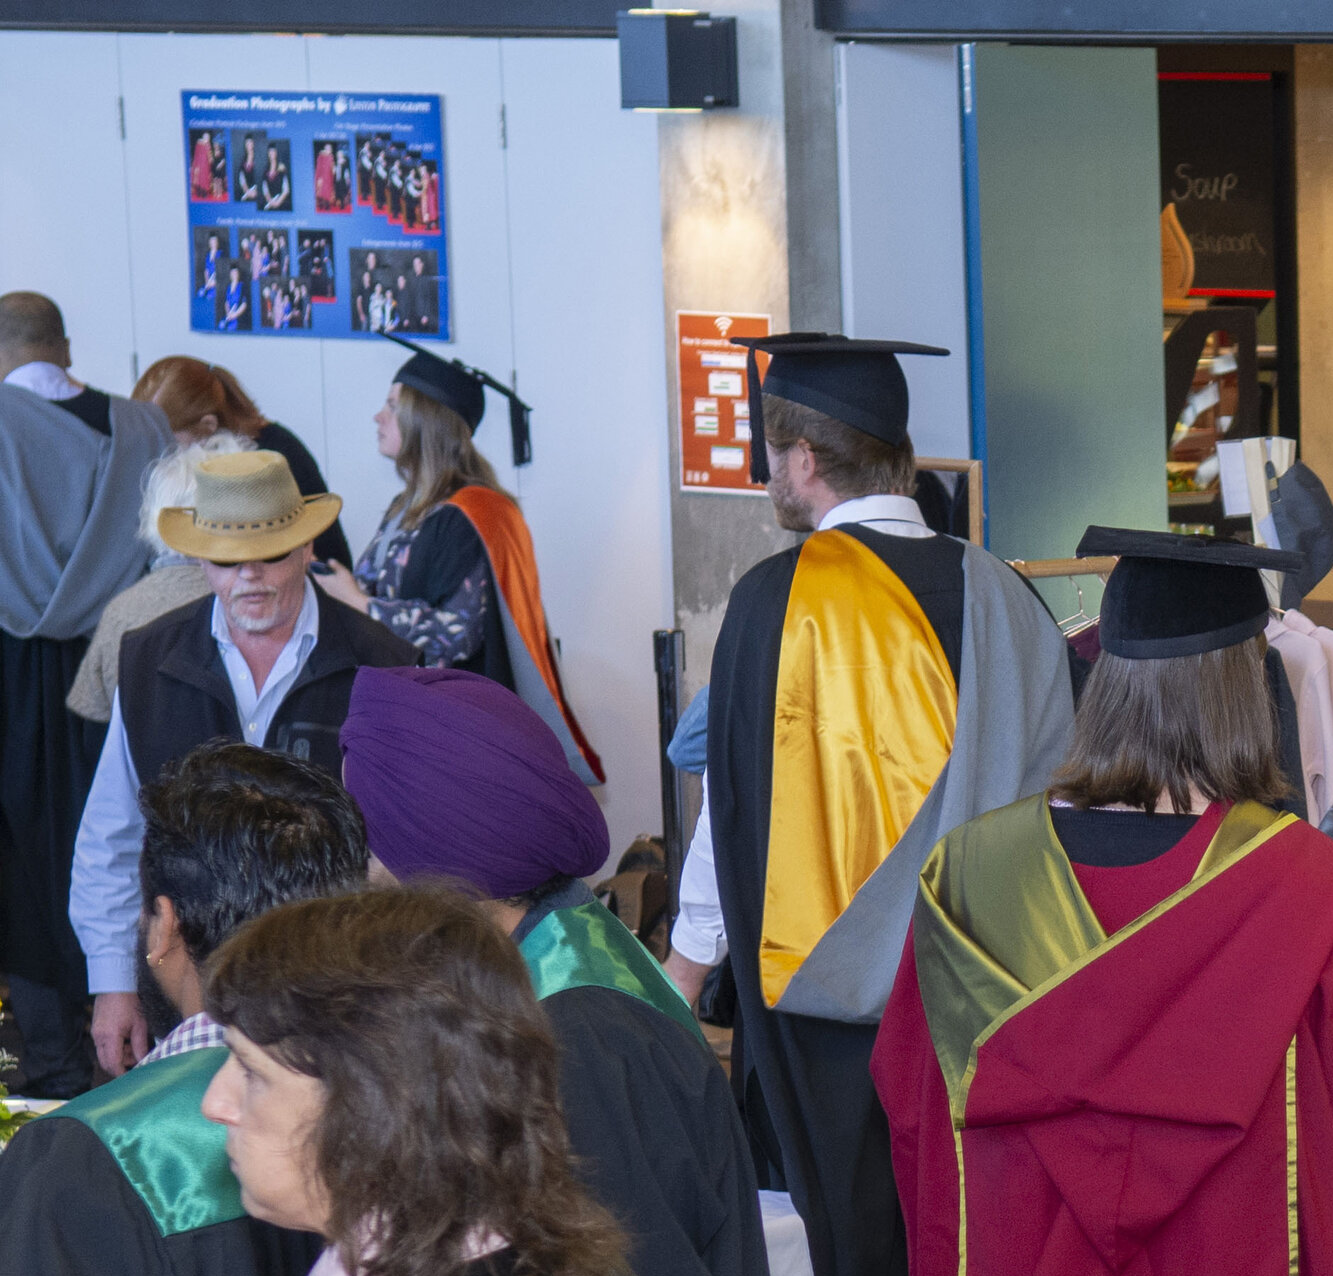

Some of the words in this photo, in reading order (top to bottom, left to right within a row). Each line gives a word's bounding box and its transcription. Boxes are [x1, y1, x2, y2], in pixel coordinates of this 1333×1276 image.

[190, 95, 249, 110] Graduation
[250, 96, 316, 114] Photographs
[317, 96, 332, 115] by
[1171, 163, 1239, 201] Soup
